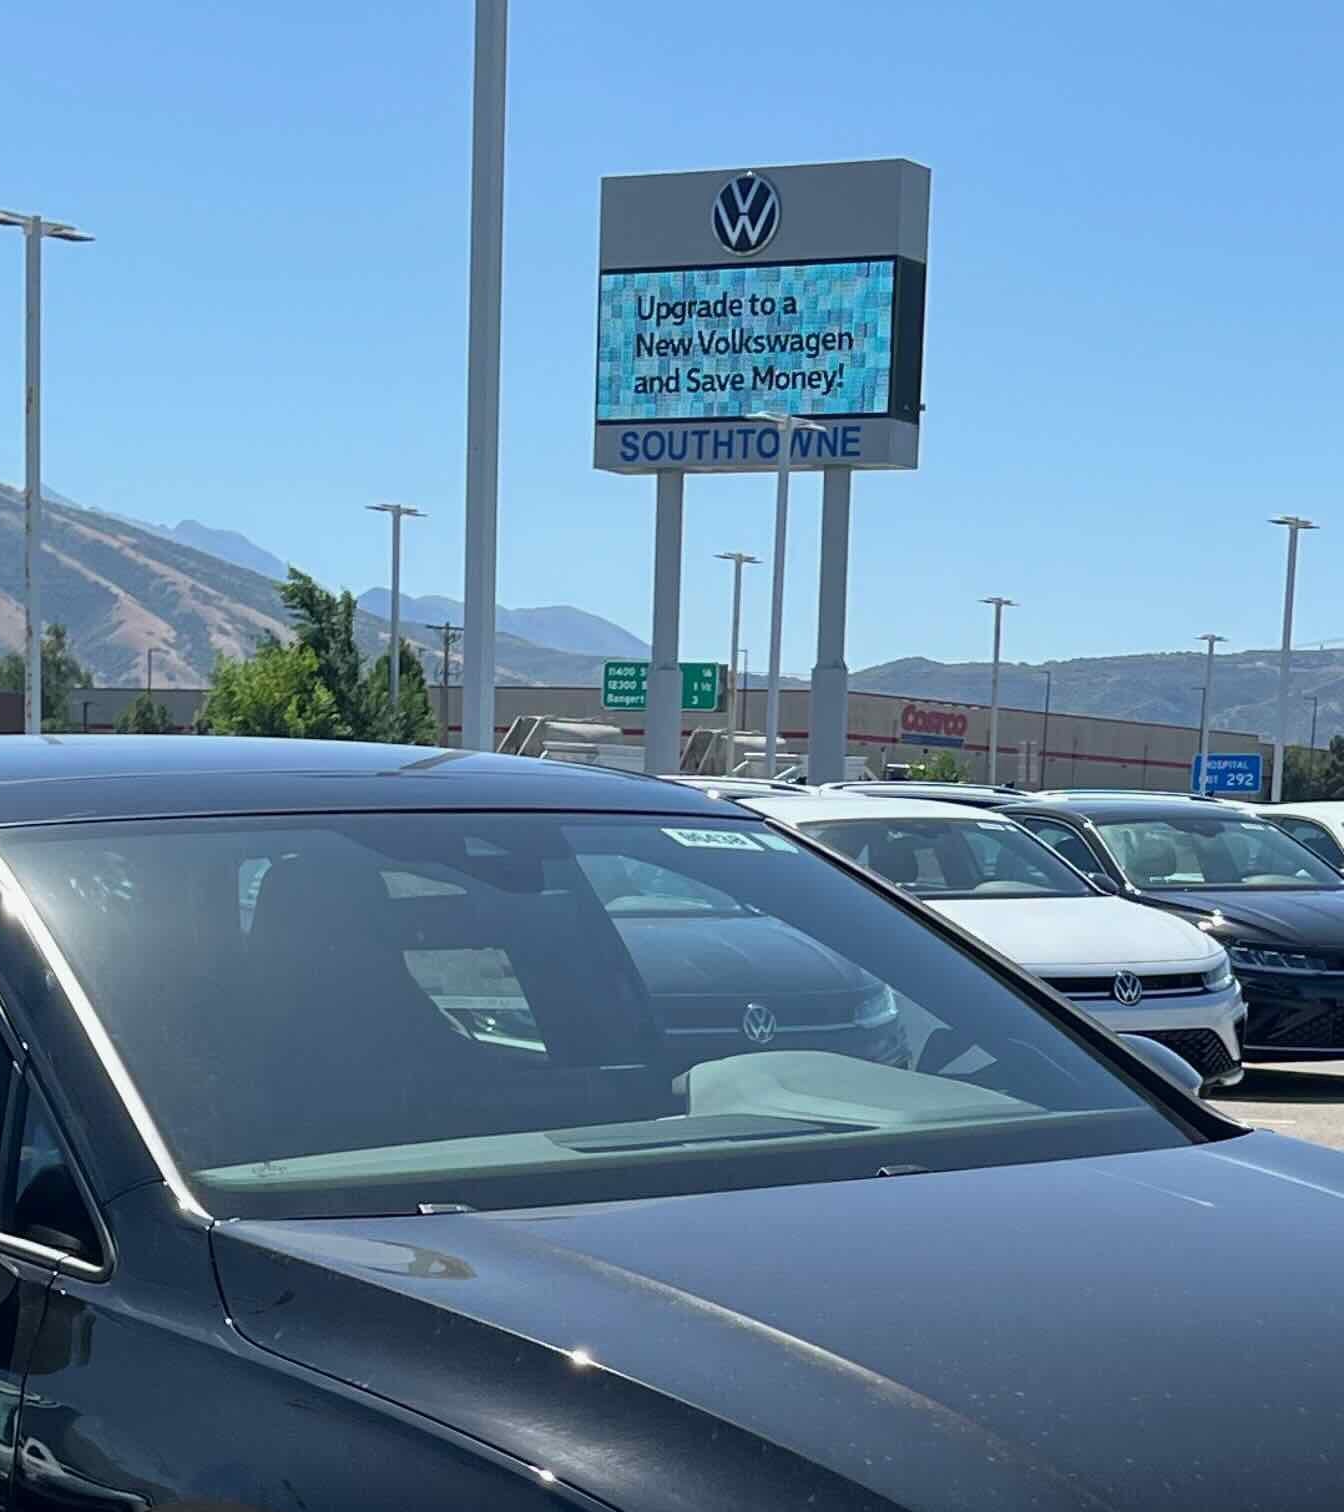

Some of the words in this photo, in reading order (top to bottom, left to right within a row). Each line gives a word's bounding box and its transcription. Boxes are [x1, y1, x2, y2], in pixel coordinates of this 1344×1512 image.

[637, 292, 742, 327] Upgrade
[748, 293, 775, 316] to
[784, 299, 797, 315] a
[636, 332, 692, 358] New
[698, 329, 854, 359] Volkswagen
[634, 368, 680, 394] and
[686, 367, 746, 393] Save
[752, 363, 845, 396] Money!
[620, 426, 862, 462] SOUTHTOWNE
[1226, 773, 1255, 786] 292
